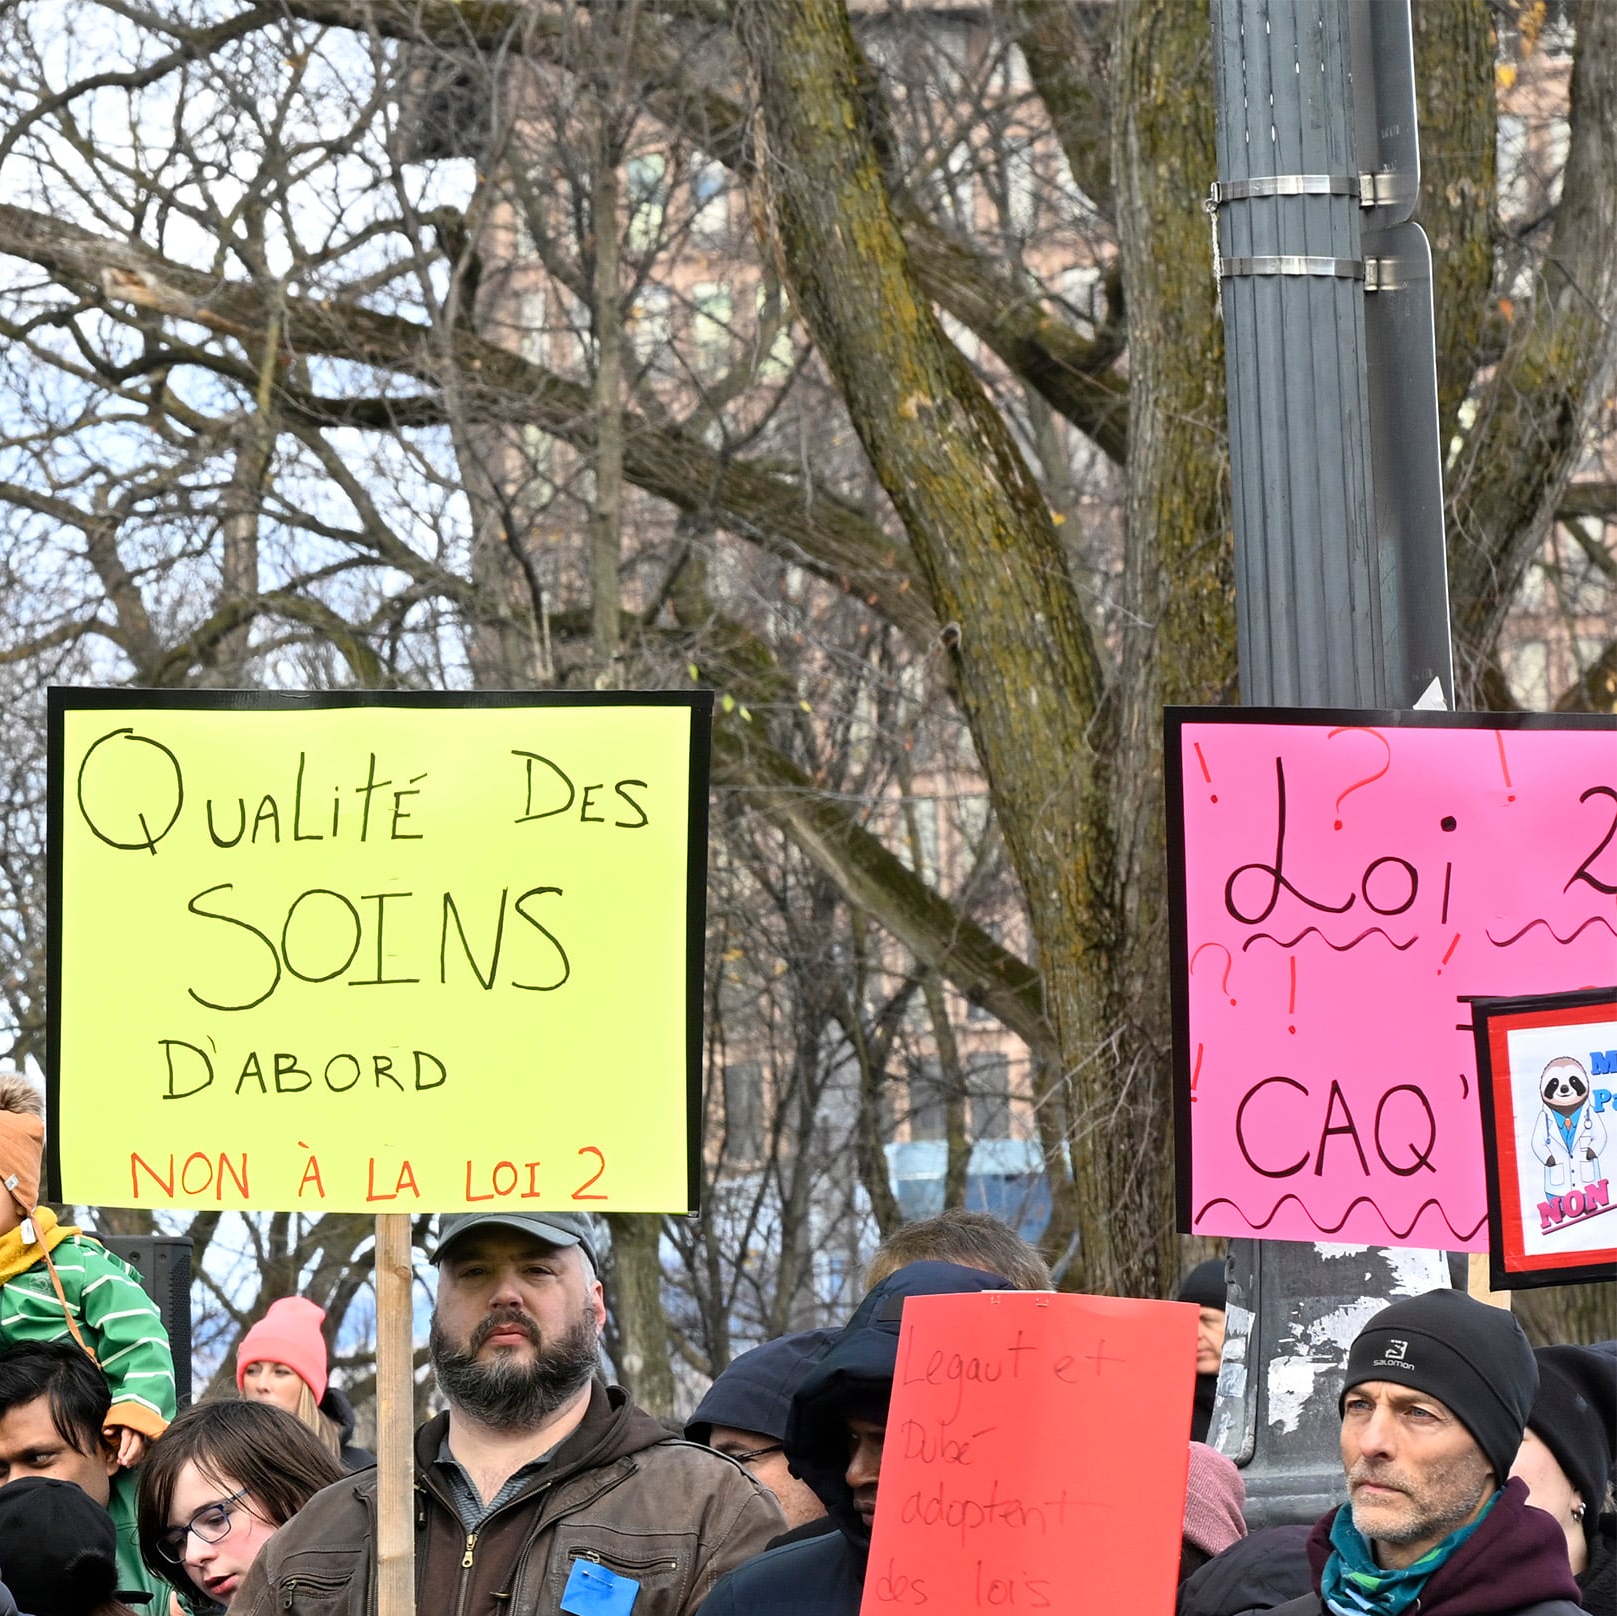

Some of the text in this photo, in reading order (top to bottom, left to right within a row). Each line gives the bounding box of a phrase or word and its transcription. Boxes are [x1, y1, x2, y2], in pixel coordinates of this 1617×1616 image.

[510, 749, 650, 829] DES
[1224, 755, 1458, 925] Loi
[186, 882, 571, 1012] SOINS
[157, 1034, 448, 1101] D'ABORD
[130, 1140, 609, 1203] NON À LA LOI 2
[1536, 1178, 1610, 1230] NON
[1053, 1338, 1128, 1385] et
[900, 1419, 997, 1467] Dubé
[900, 1481, 1114, 1547] adoptent
[876, 1558, 1051, 1608] des lois
